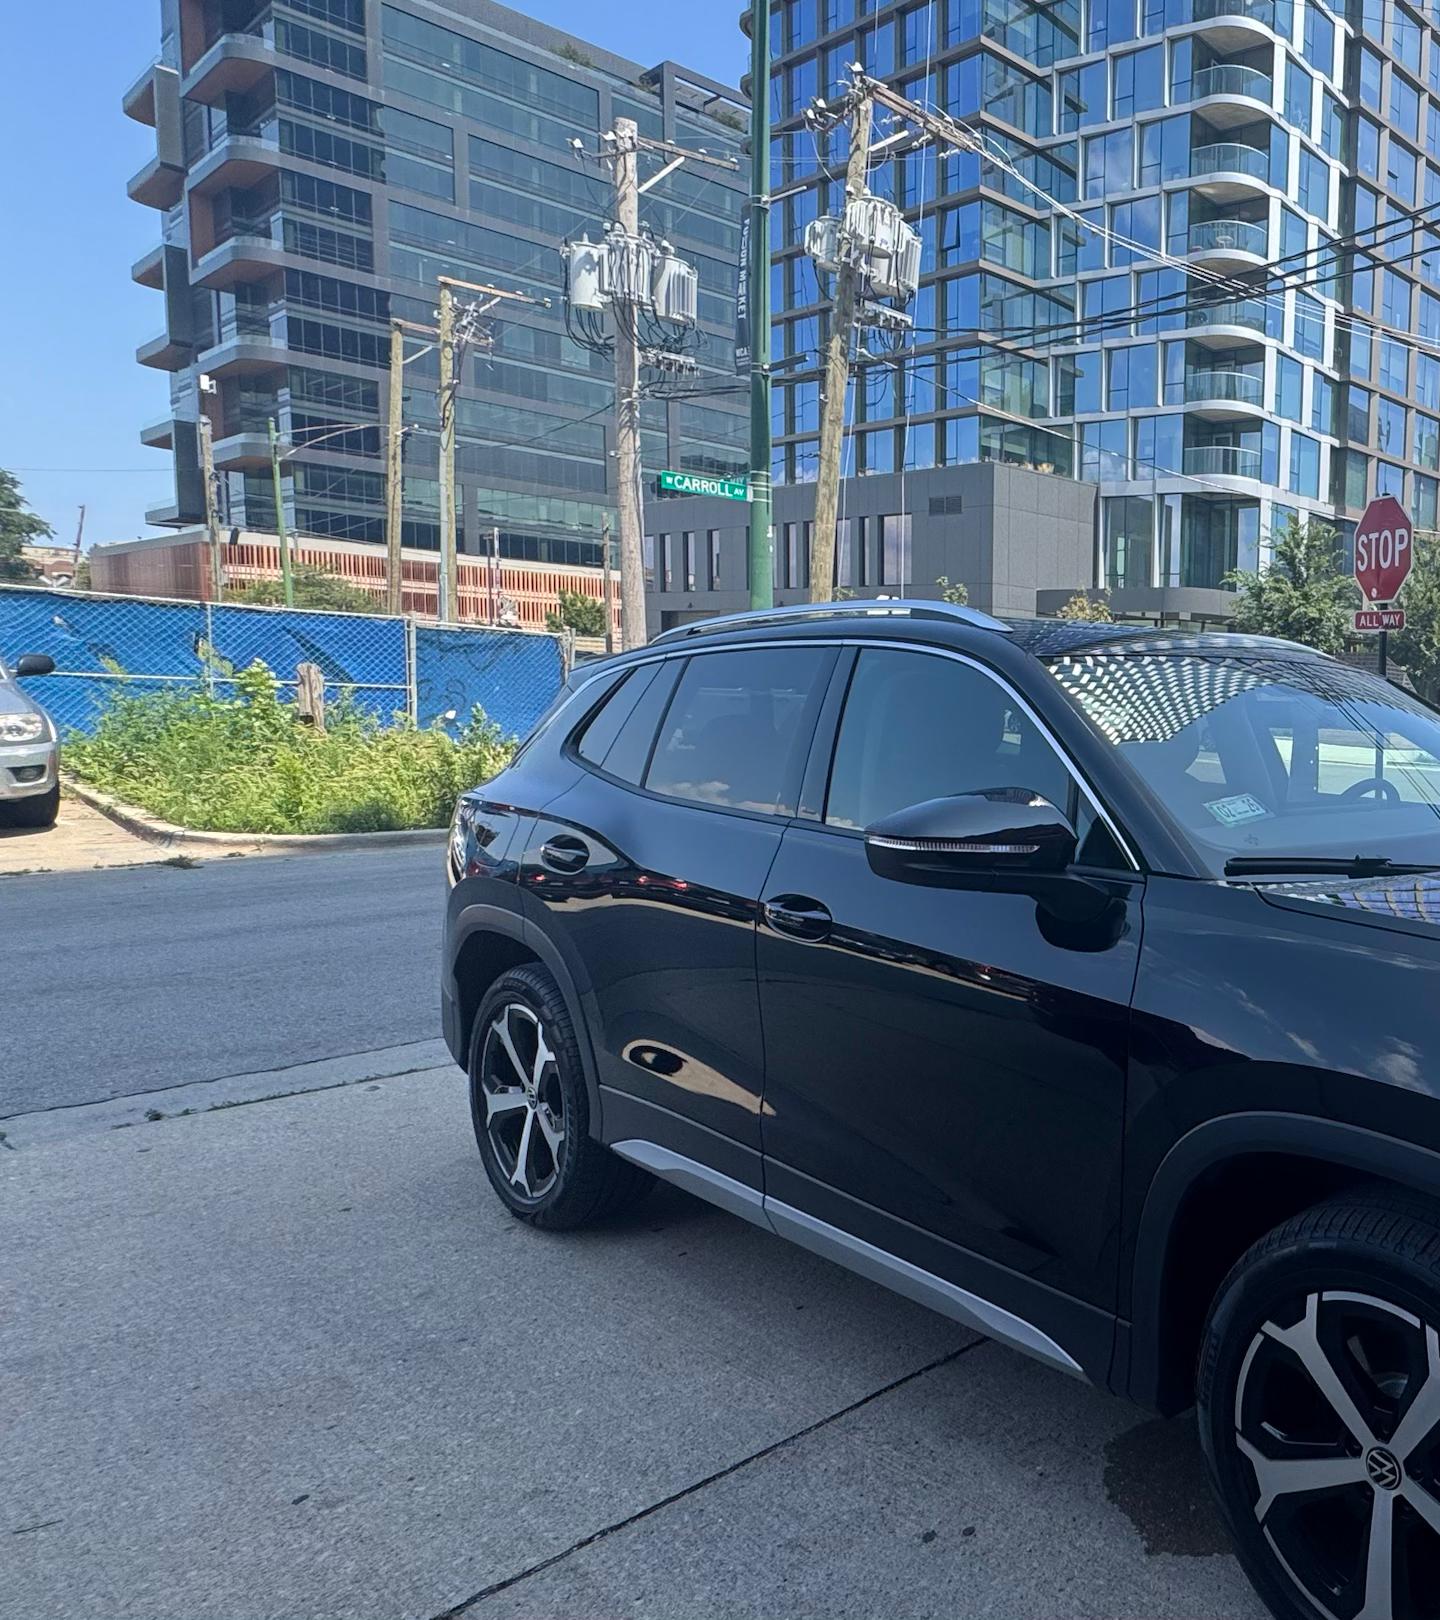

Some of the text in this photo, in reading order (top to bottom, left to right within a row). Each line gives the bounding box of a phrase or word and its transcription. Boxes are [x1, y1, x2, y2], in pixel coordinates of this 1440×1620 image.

[665, 475, 744, 497] W CARROLL AV
[1357, 527, 1409, 572] STOP
[1359, 613, 1401, 627] ALL WAY
